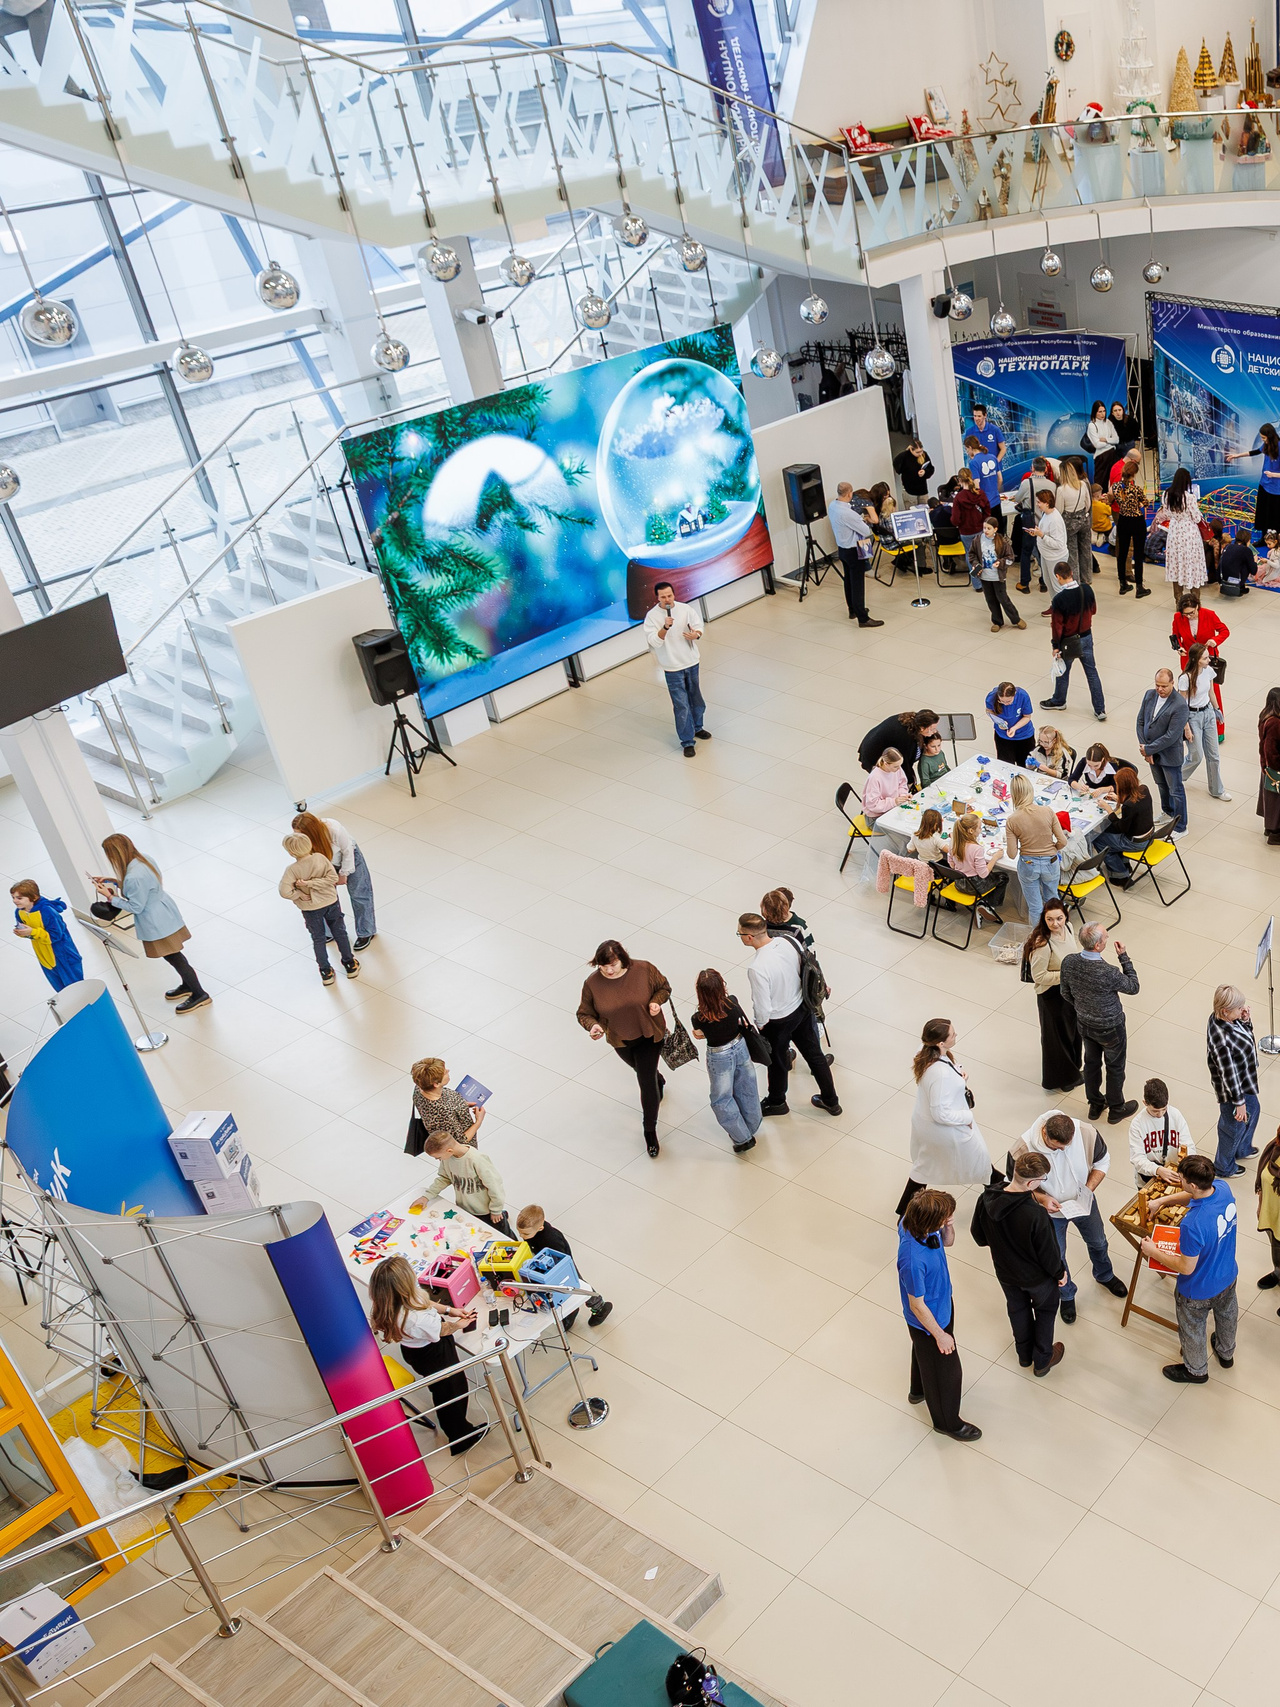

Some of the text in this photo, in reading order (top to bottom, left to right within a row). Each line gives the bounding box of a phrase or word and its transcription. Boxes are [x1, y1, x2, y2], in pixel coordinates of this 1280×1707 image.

[1197, 323, 1241, 335] Министерство
[1005, 339, 1039, 347] образования
[998, 353, 1091, 364] НАЦИОНАЛЬНЫЙ ДЕТСКИЙ
[998, 360, 1090, 373] ТЕХНОПАРК
